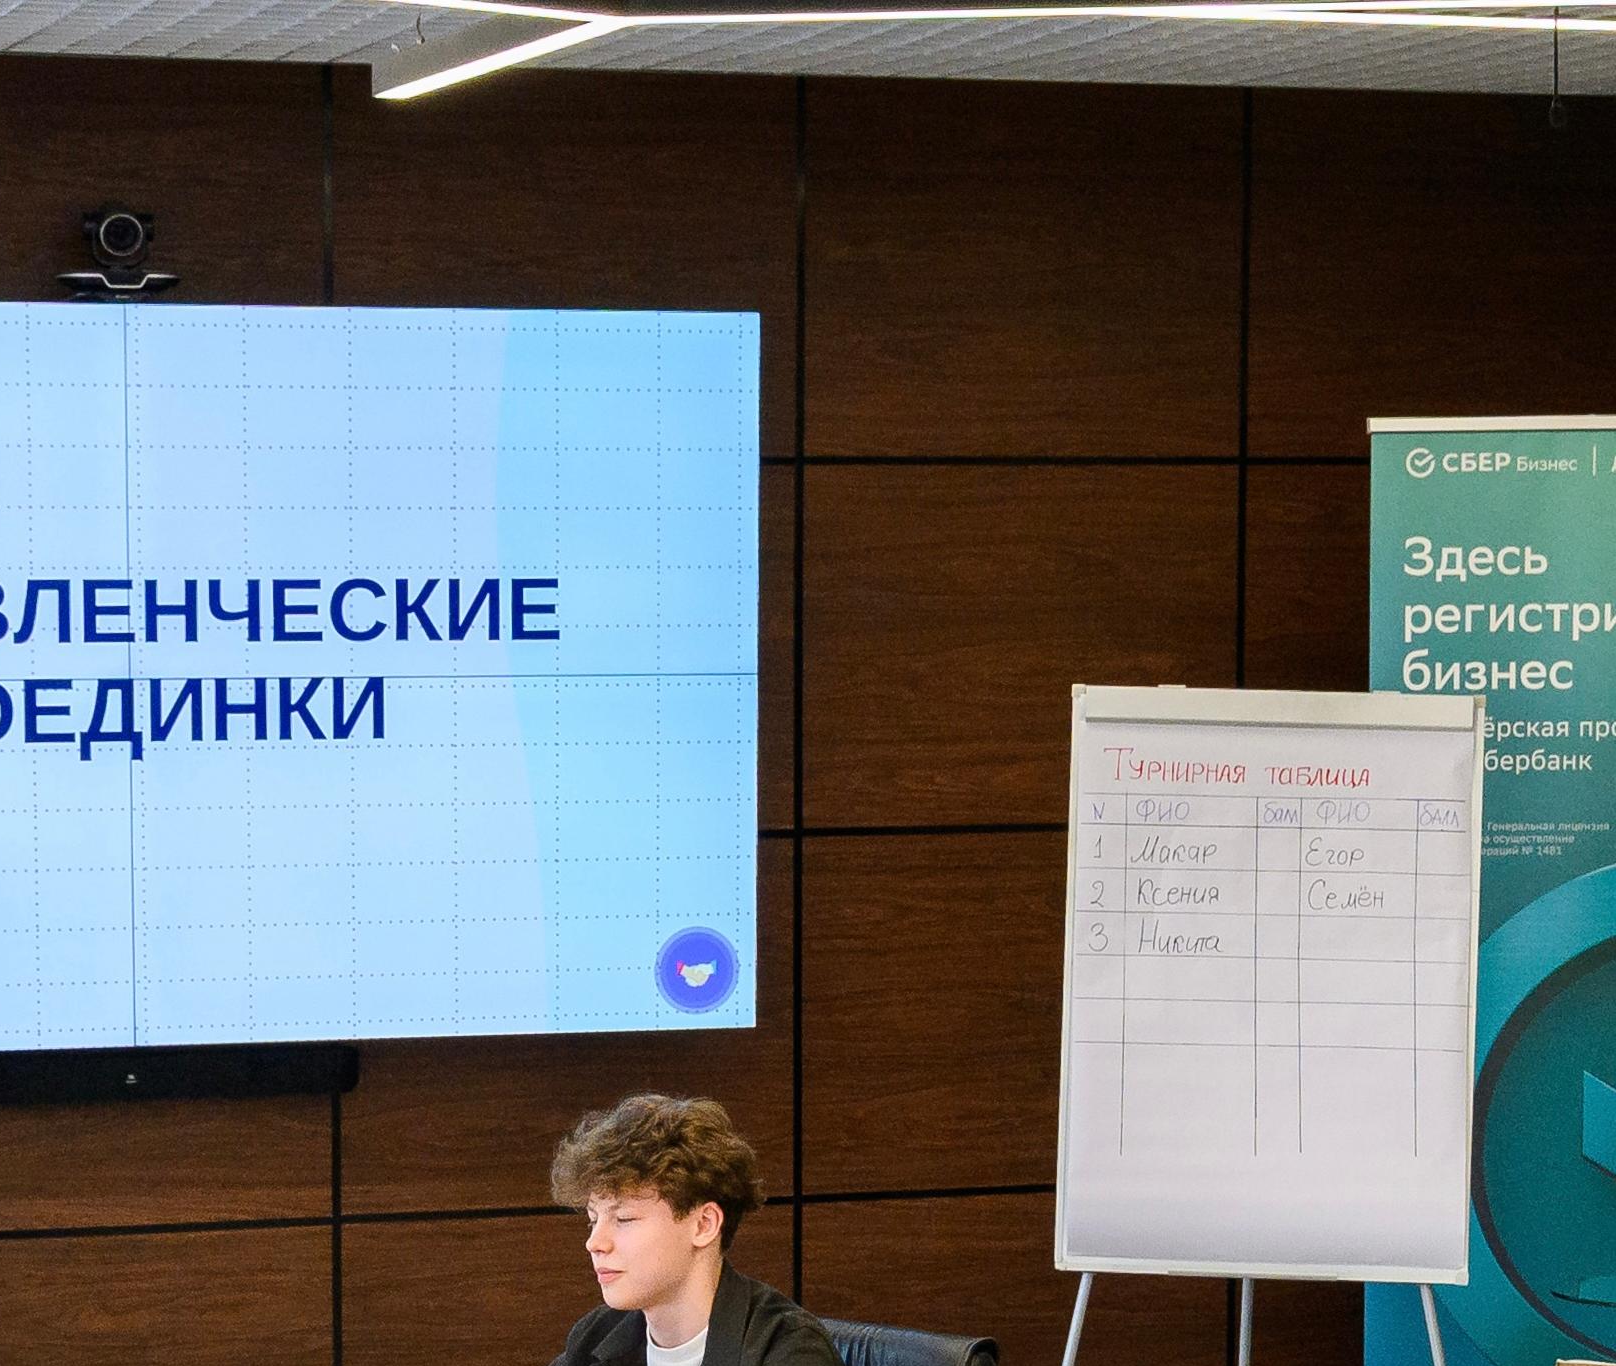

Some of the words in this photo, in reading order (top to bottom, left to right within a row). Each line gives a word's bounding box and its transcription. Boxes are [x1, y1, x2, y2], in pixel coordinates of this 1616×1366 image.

[1442, 453, 1511, 472] СБЕР
[1516, 456, 1578, 472] Бизнес
[1403, 536, 1549, 582] Здесь
[1402, 649, 1574, 692] бизнес
[1103, 747, 1246, 784] Турнирная
[1265, 767, 1370, 788] таблица
[1484, 749, 1593, 775] бербанк
[1136, 799, 1190, 822] ФИО
[1316, 800, 1371, 825] ФИО
[1487, 822, 1555, 832] Генеральная
[1557, 822, 1610, 832] лицензия
[1492, 835, 1576, 845] осуществление
[1093, 835, 1102, 858] 1
[1131, 835, 1218, 864] Макар
[1305, 836, 1365, 867] Егор
[1537, 845, 1563, 856] 1481
[1090, 880, 1104, 908] 2
[1137, 877, 1220, 907] Ксения
[1308, 878, 1385, 911] Семён
[1089, 922, 1109, 952] 3
[1138, 917, 1222, 953] Никита
